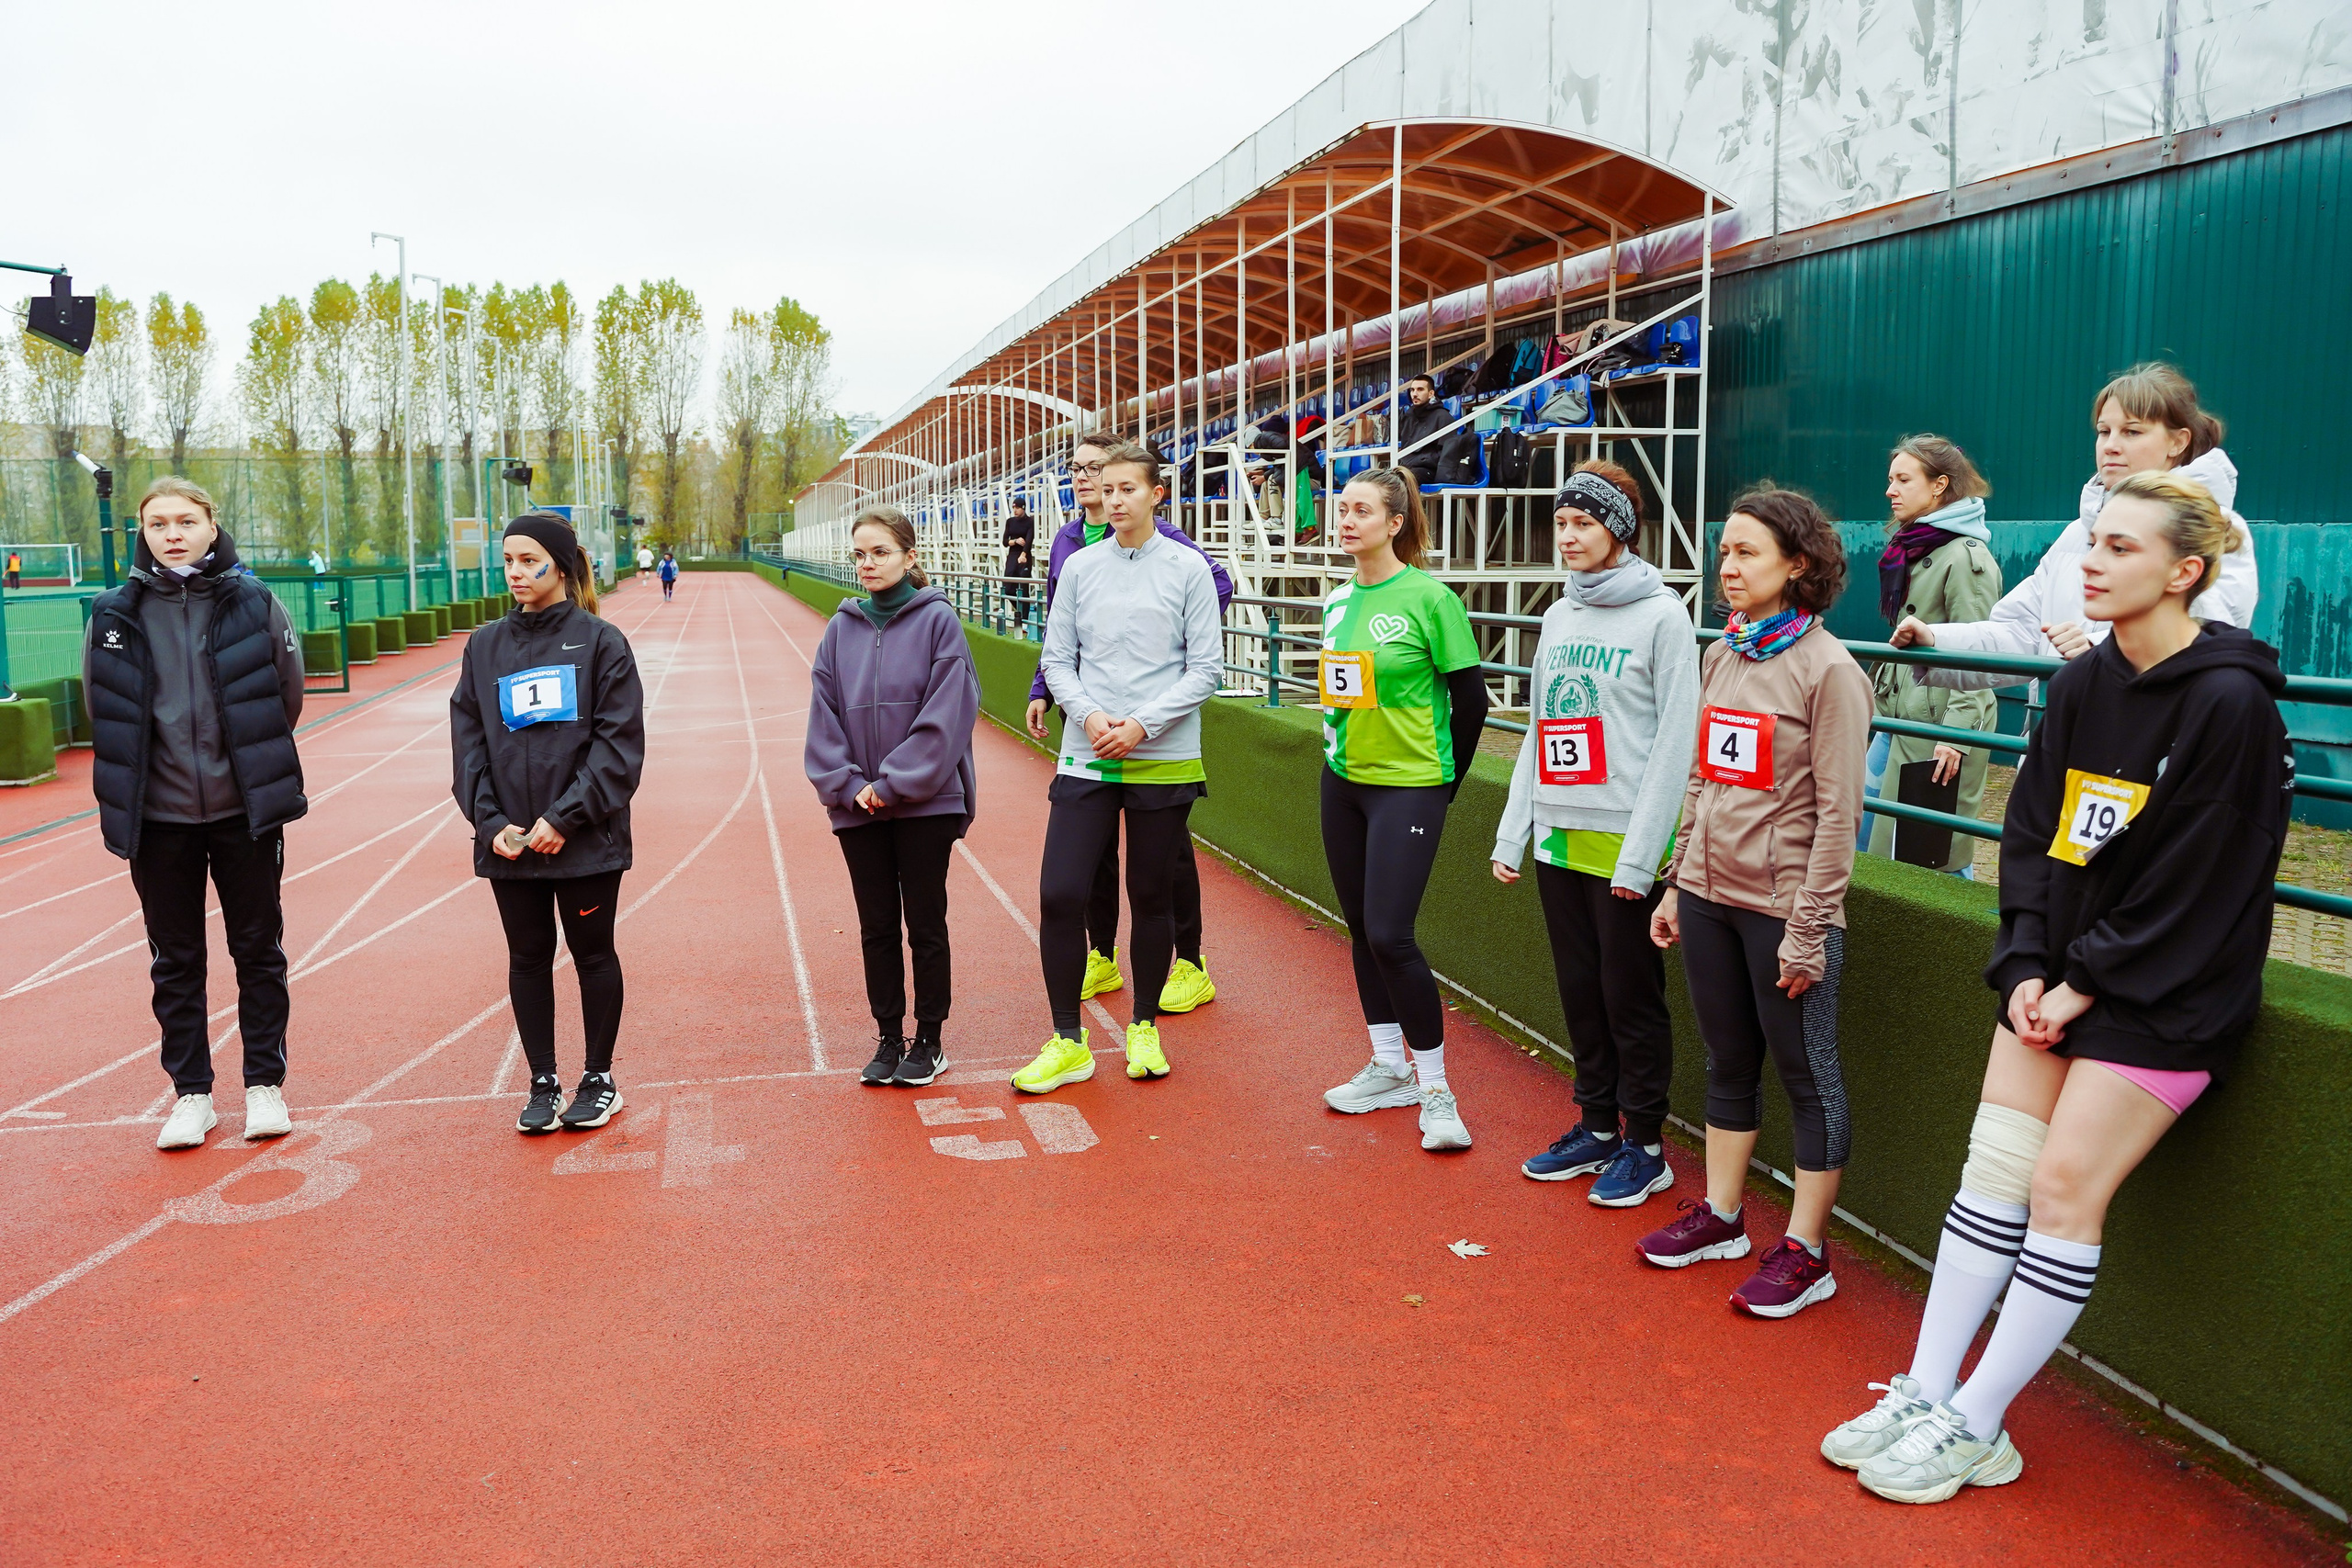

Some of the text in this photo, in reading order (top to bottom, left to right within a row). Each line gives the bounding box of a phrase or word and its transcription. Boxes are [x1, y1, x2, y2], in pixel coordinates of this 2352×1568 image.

[1544, 643, 1634, 680] VERMONT
[518, 670, 560, 681] SUPERSPORT
[1335, 668, 1348, 691] 5
[528, 683, 541, 706] 1
[1548, 724, 1587, 732] SUPERSPORT
[1716, 713, 1759, 726] SUPERSPORT
[1550, 739, 1578, 766] 13
[1720, 732, 1739, 762] 4
[2091, 782, 2133, 798] SUPERSPORT
[2078, 803, 2116, 842] 19
